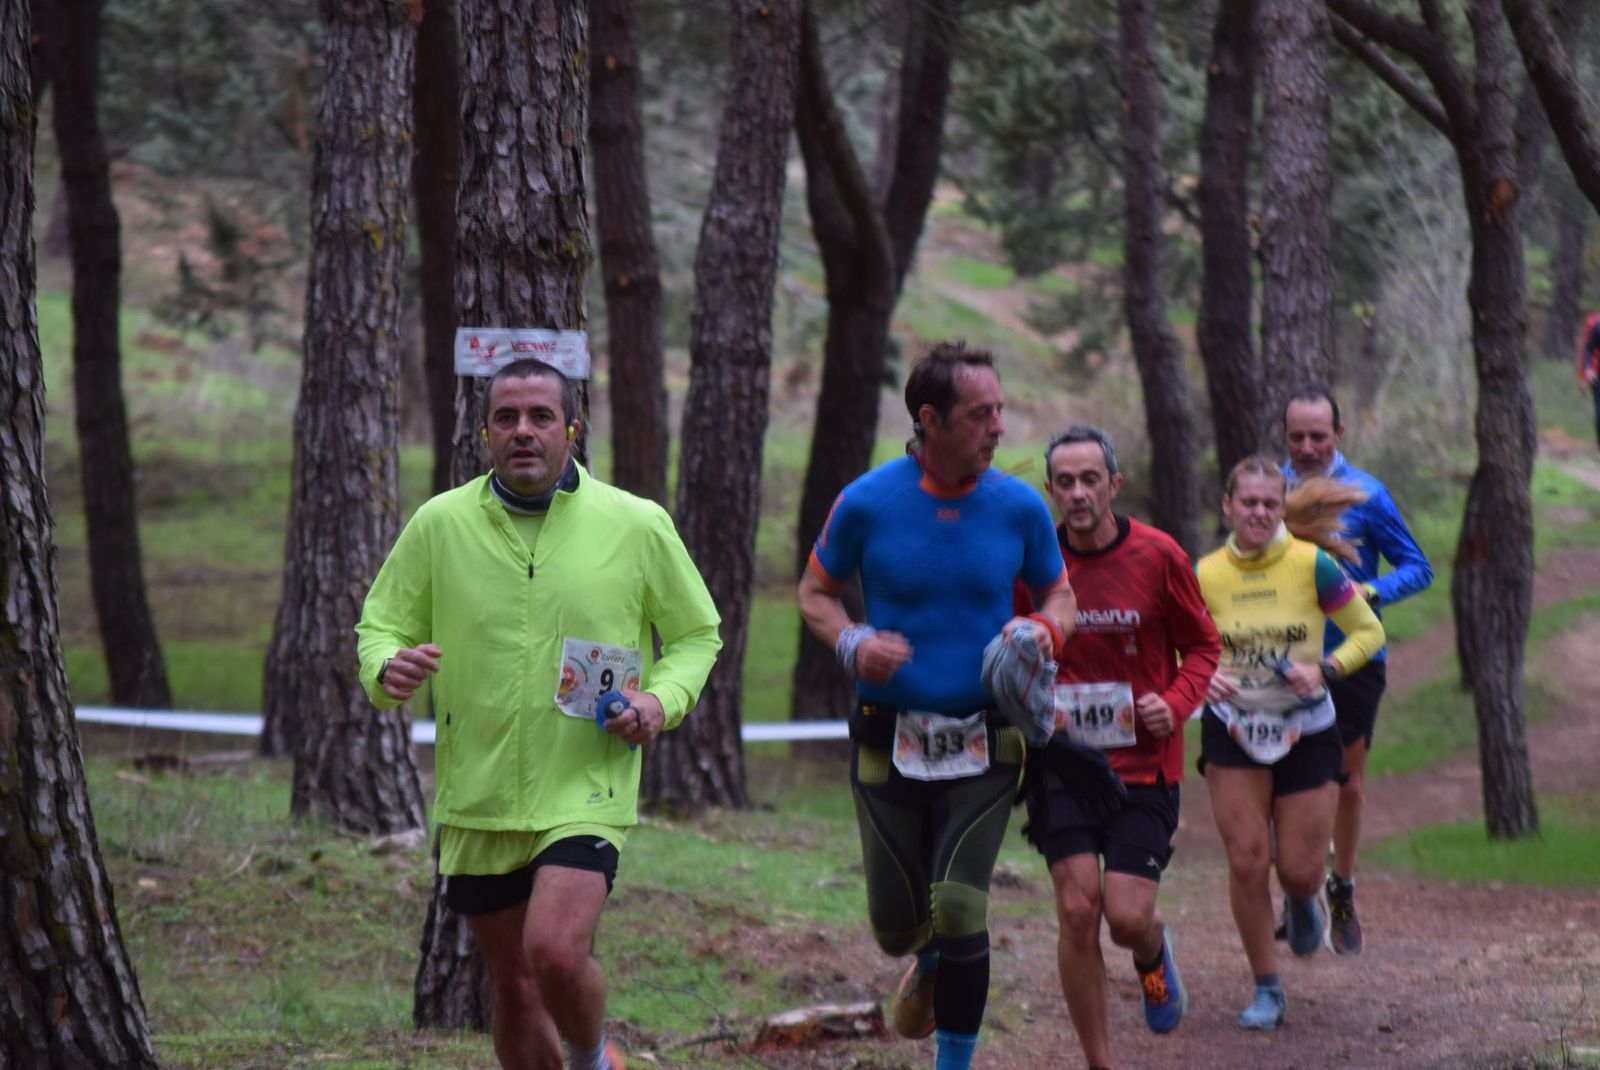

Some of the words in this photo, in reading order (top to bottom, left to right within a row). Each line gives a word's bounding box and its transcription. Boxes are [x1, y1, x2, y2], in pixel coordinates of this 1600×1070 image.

[599, 668, 614, 695] 9
[1072, 704, 1114, 730] 149
[919, 731, 965, 761] 133
[1246, 723, 1283, 745] 195
